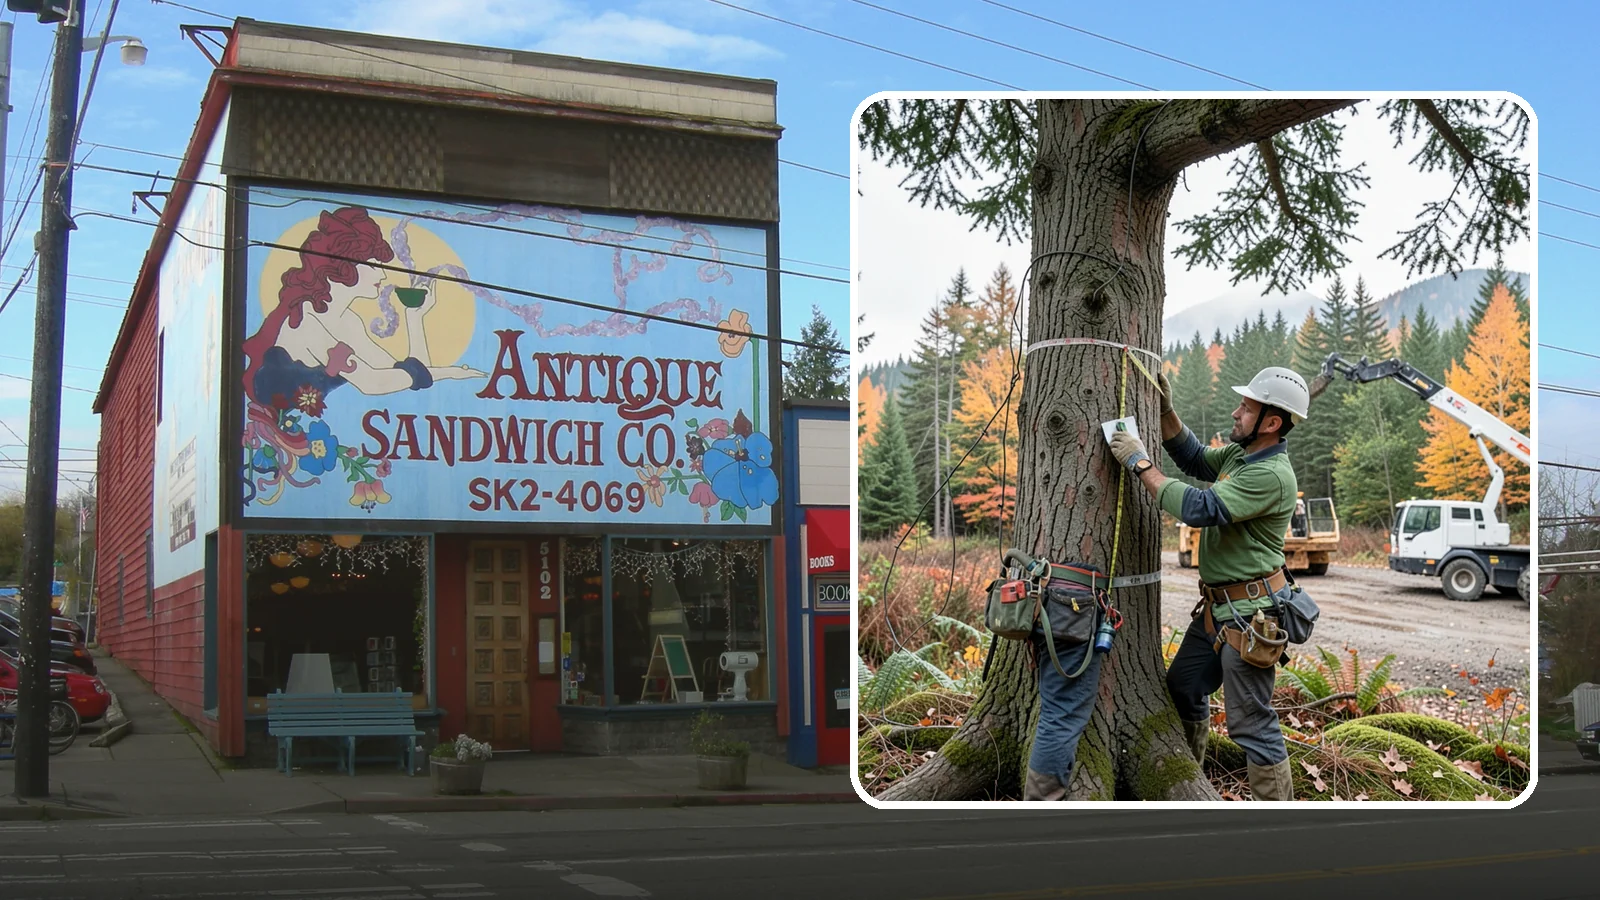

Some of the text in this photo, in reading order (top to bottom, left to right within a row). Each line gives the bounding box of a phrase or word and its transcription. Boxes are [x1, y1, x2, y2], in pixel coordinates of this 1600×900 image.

[475, 329, 723, 421] ANTIQUE
[361, 408, 685, 469] SANDWICH CO.
[468, 477, 645, 513] SK2-4069
[809, 555, 835, 569] BOOKS
